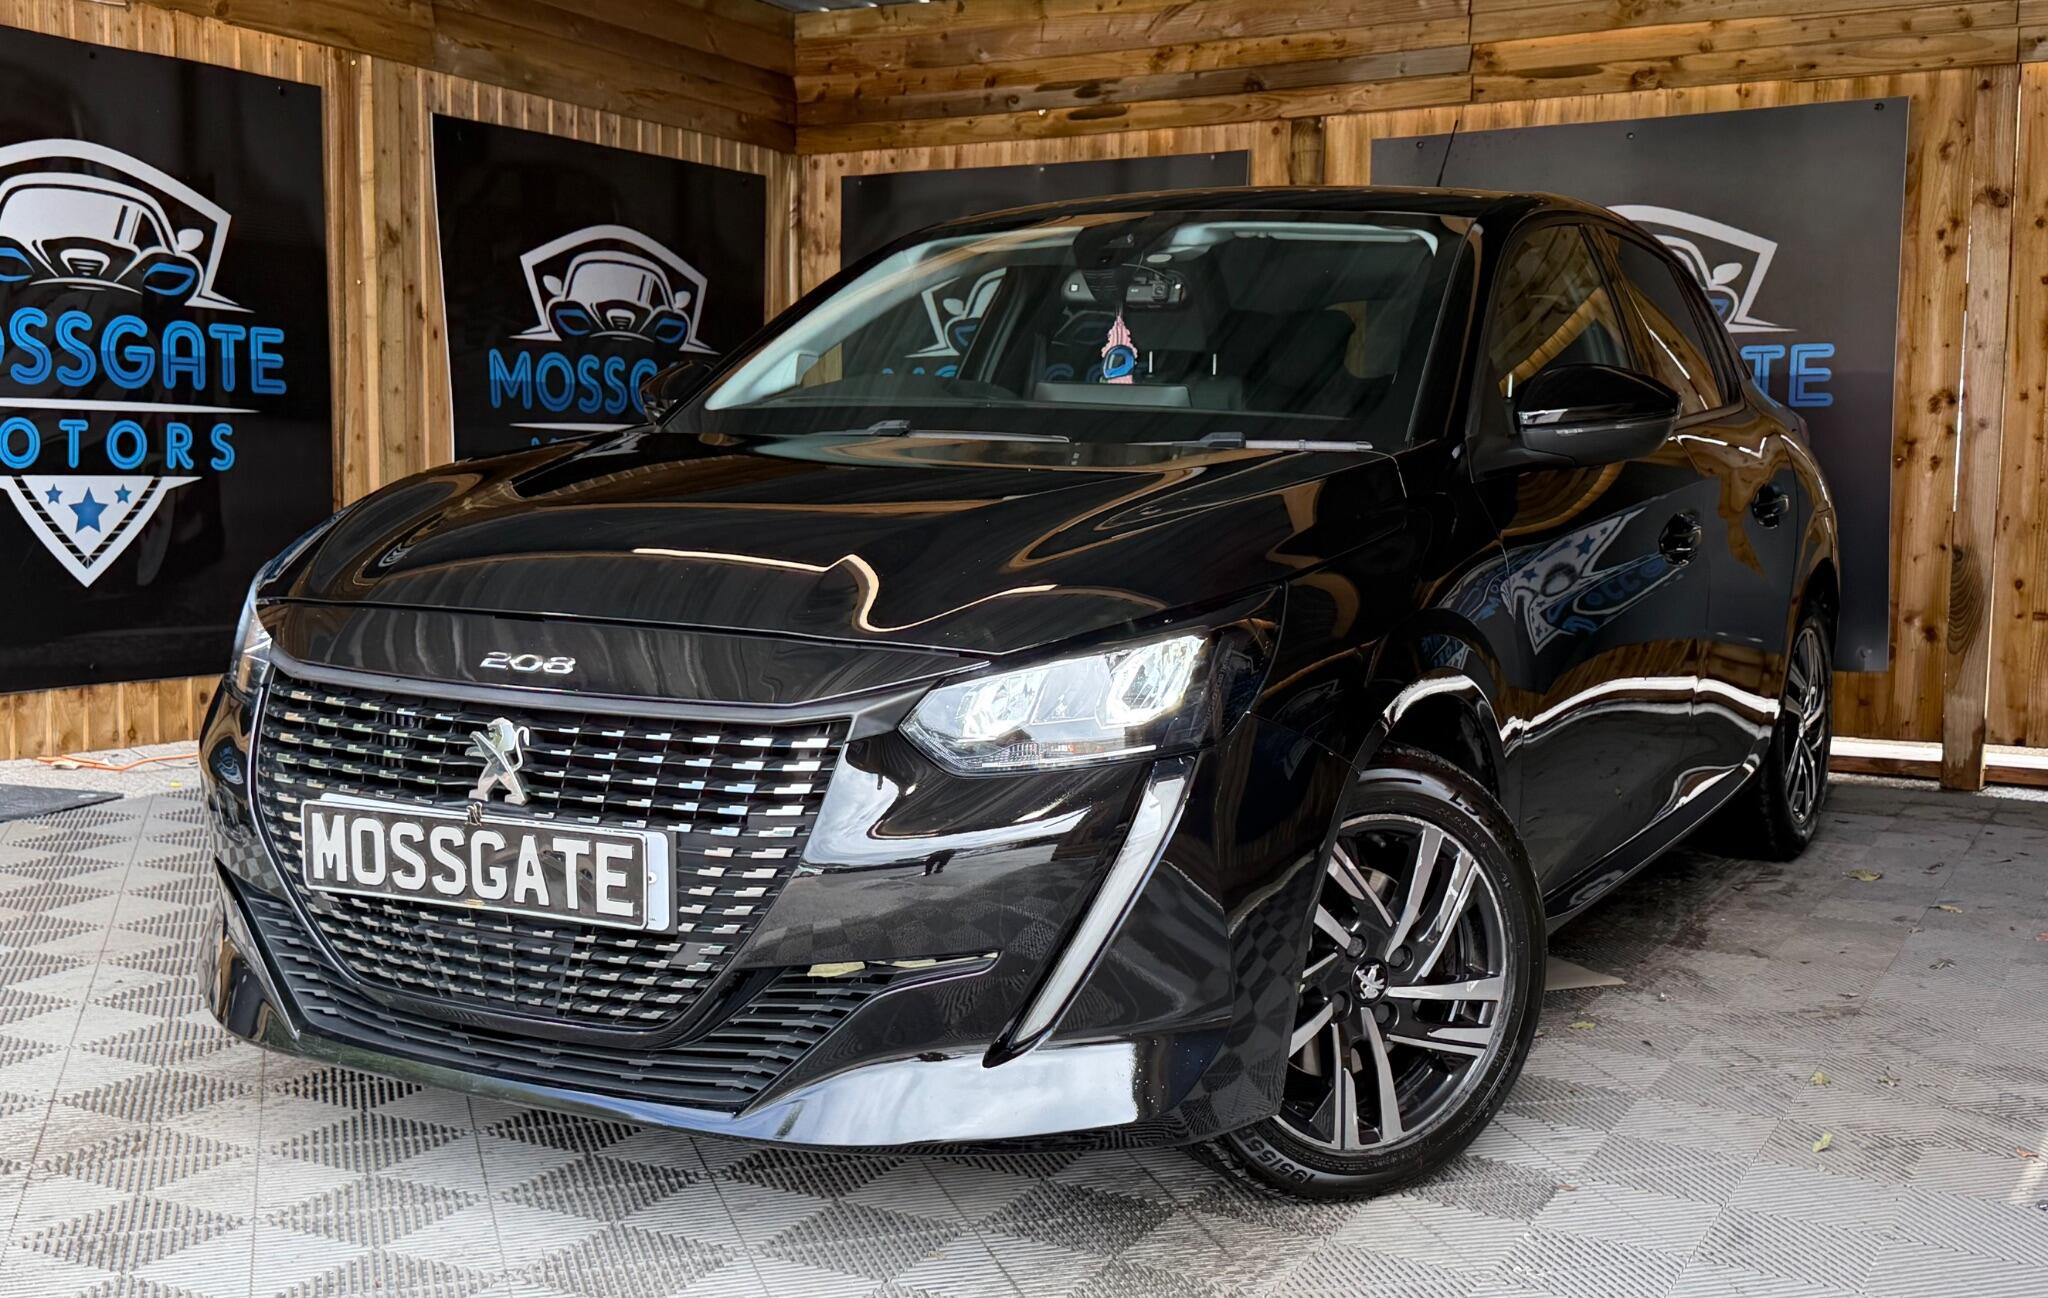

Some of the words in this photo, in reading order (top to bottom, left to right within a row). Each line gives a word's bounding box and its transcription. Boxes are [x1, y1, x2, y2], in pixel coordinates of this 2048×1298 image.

[0, 307, 286, 394] SSGATE
[0, 417, 235, 471] OTORS
[480, 651, 576, 674] 208
[311, 812, 634, 917] MOSSGATE
